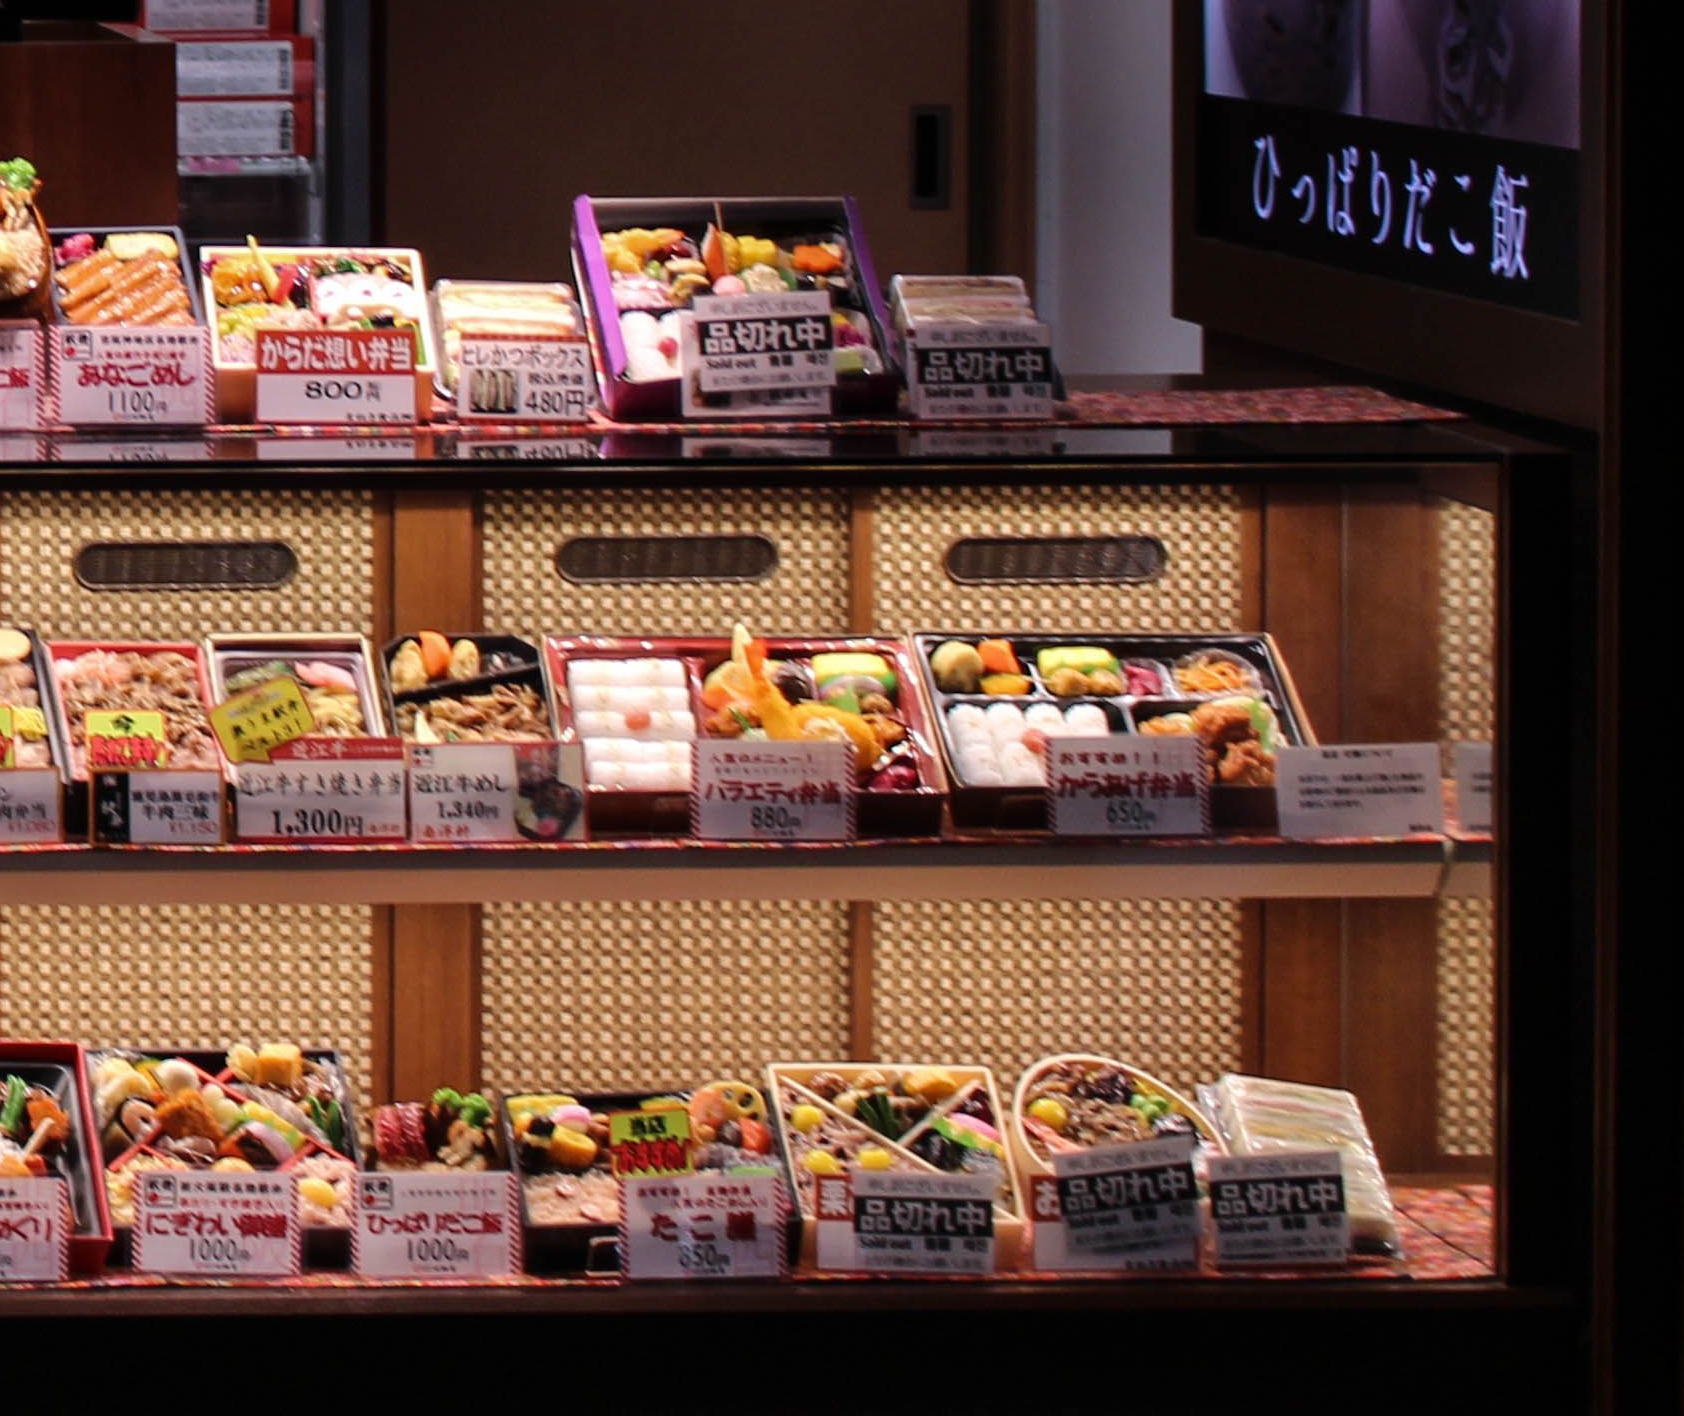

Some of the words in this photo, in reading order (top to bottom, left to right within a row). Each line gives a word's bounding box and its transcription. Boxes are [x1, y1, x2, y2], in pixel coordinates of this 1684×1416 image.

[1253, 134, 1528, 279] ひっぱりだこ飯
[704, 319, 827, 355] 品切れ中
[261, 335, 413, 372] からだ想い弁当
[462, 345, 585, 369] ヒレかつボックス
[923, 351, 1044, 382] 品切れ中
[77, 362, 195, 387] あなごめし
[525, 389, 585, 417] 480円
[703, 779, 842, 806] バラエティ弁当
[1056, 772, 1196, 800] から揚げ弁当
[1067, 1172, 1192, 1213] 品切れ中
[1216, 1185, 1339, 1216] 品切れ中
[860, 1200, 989, 1233] 品切れ中
